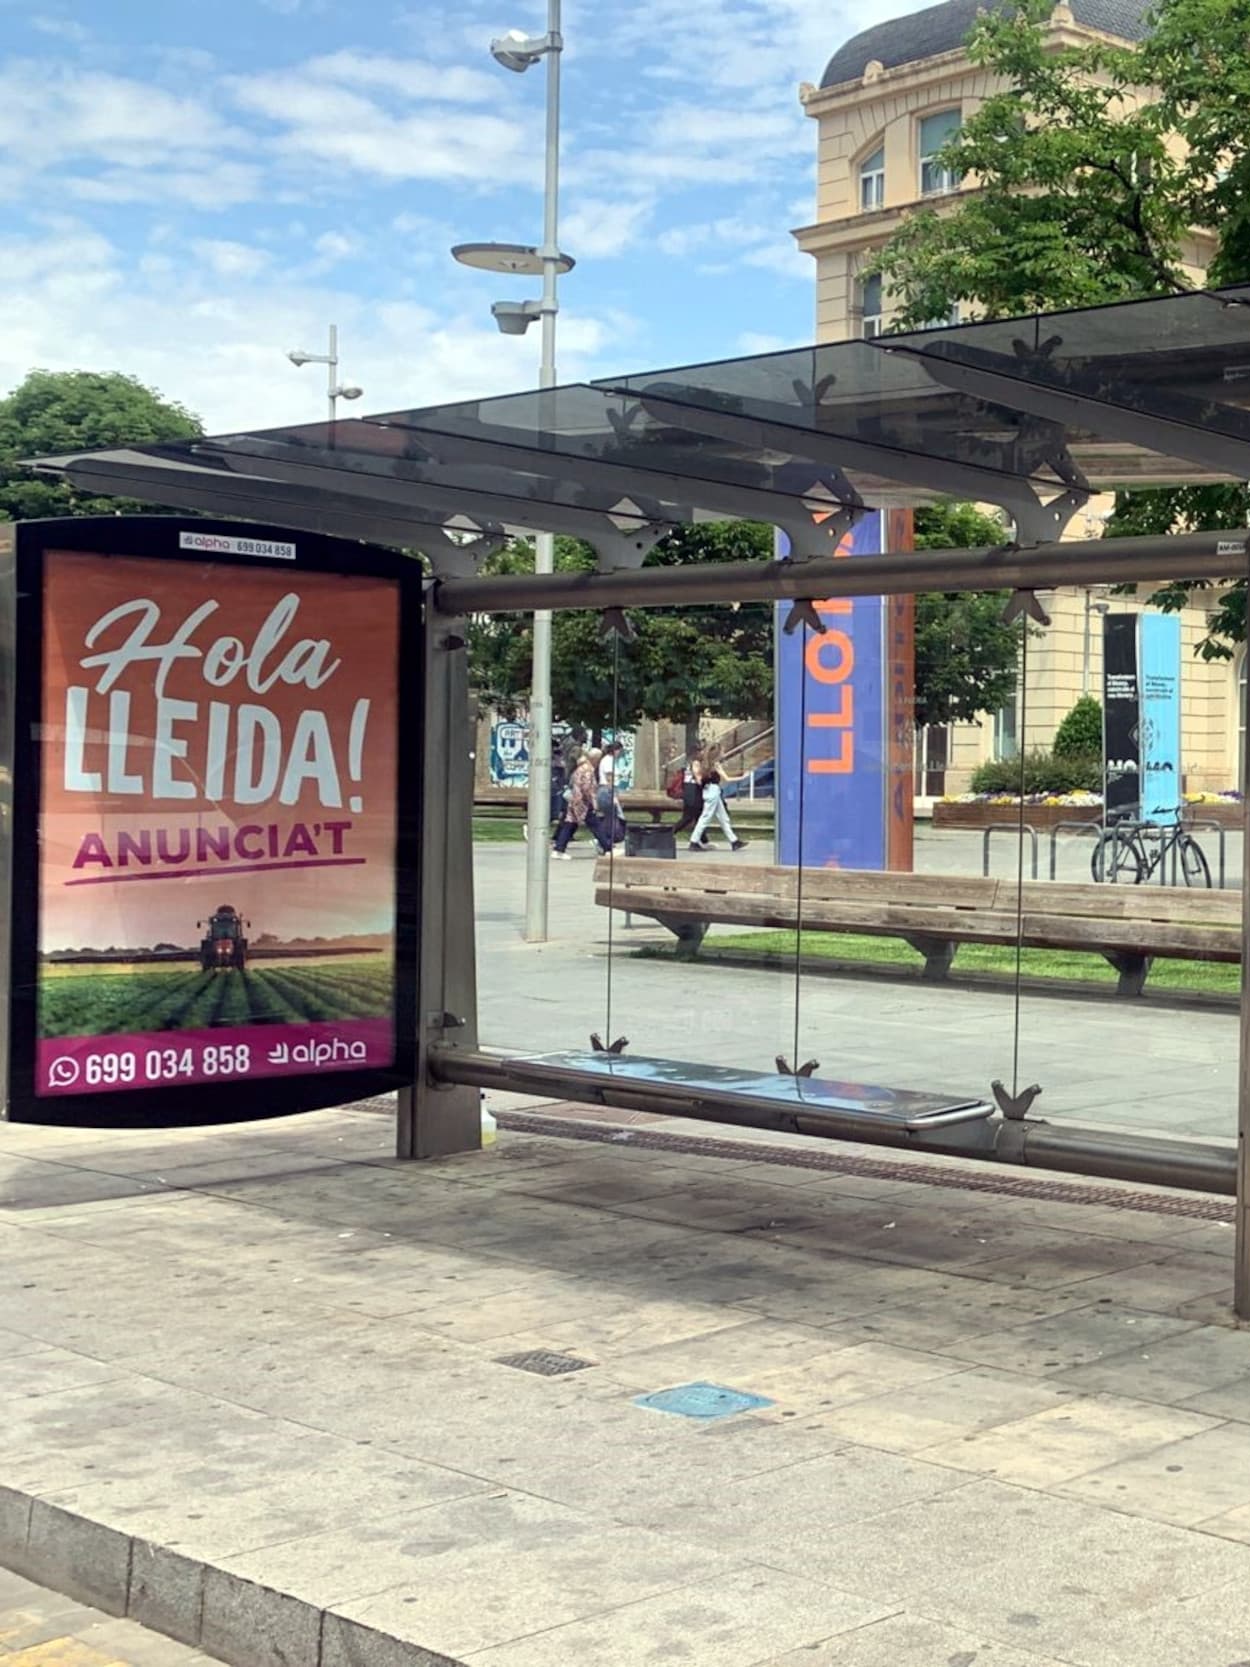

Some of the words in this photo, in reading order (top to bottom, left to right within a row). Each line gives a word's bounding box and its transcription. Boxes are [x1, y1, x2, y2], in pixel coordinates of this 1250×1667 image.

[194, 536, 230, 549] alpha
[237, 541, 254, 553] 699
[255, 543, 273, 555] 034
[274, 544, 292, 557] 858
[80, 592, 341, 699] Hola
[64, 686, 370, 813] LLEIDA!
[85, 1052, 136, 1085] 699
[145, 1048, 195, 1081] 034
[202, 1044, 250, 1076] 858
[292, 1038, 367, 1067] alpha
